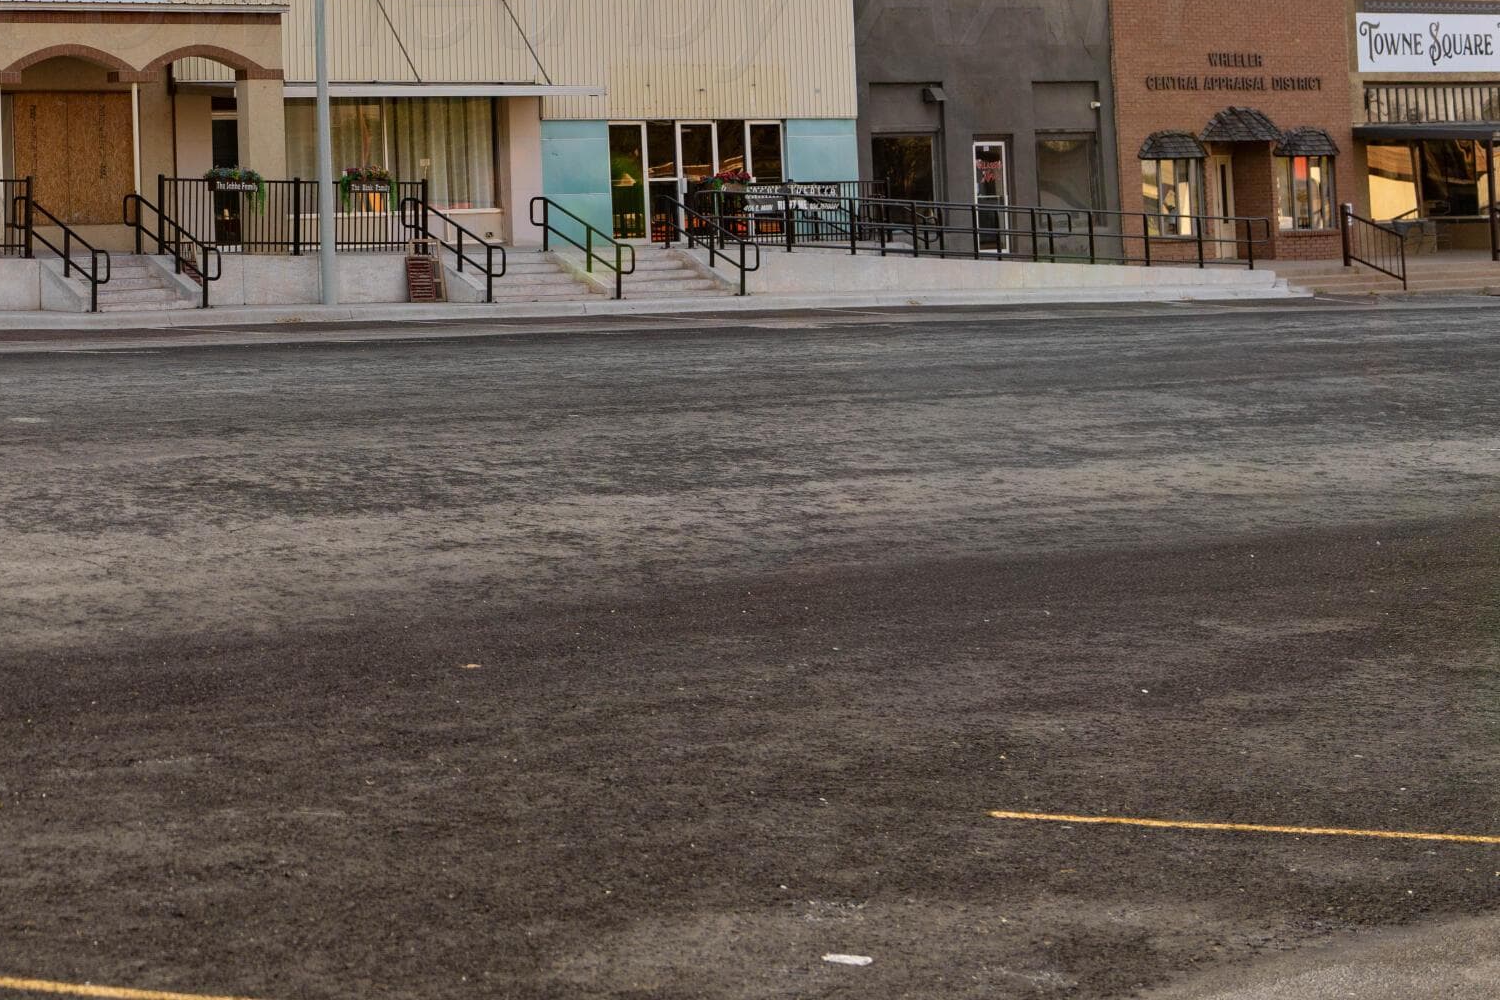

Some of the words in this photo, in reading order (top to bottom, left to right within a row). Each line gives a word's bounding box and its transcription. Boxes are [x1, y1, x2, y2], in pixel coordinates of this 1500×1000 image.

[1359, 20, 1424, 63] TOWNE
[1428, 20, 1494, 66] SQUARE
[1208, 53, 1263, 67] WHEELER
[1145, 75, 1200, 91] CENTRAL
[1203, 75, 1267, 91] APPRAISAL
[1271, 76, 1322, 91] DISTRICT
